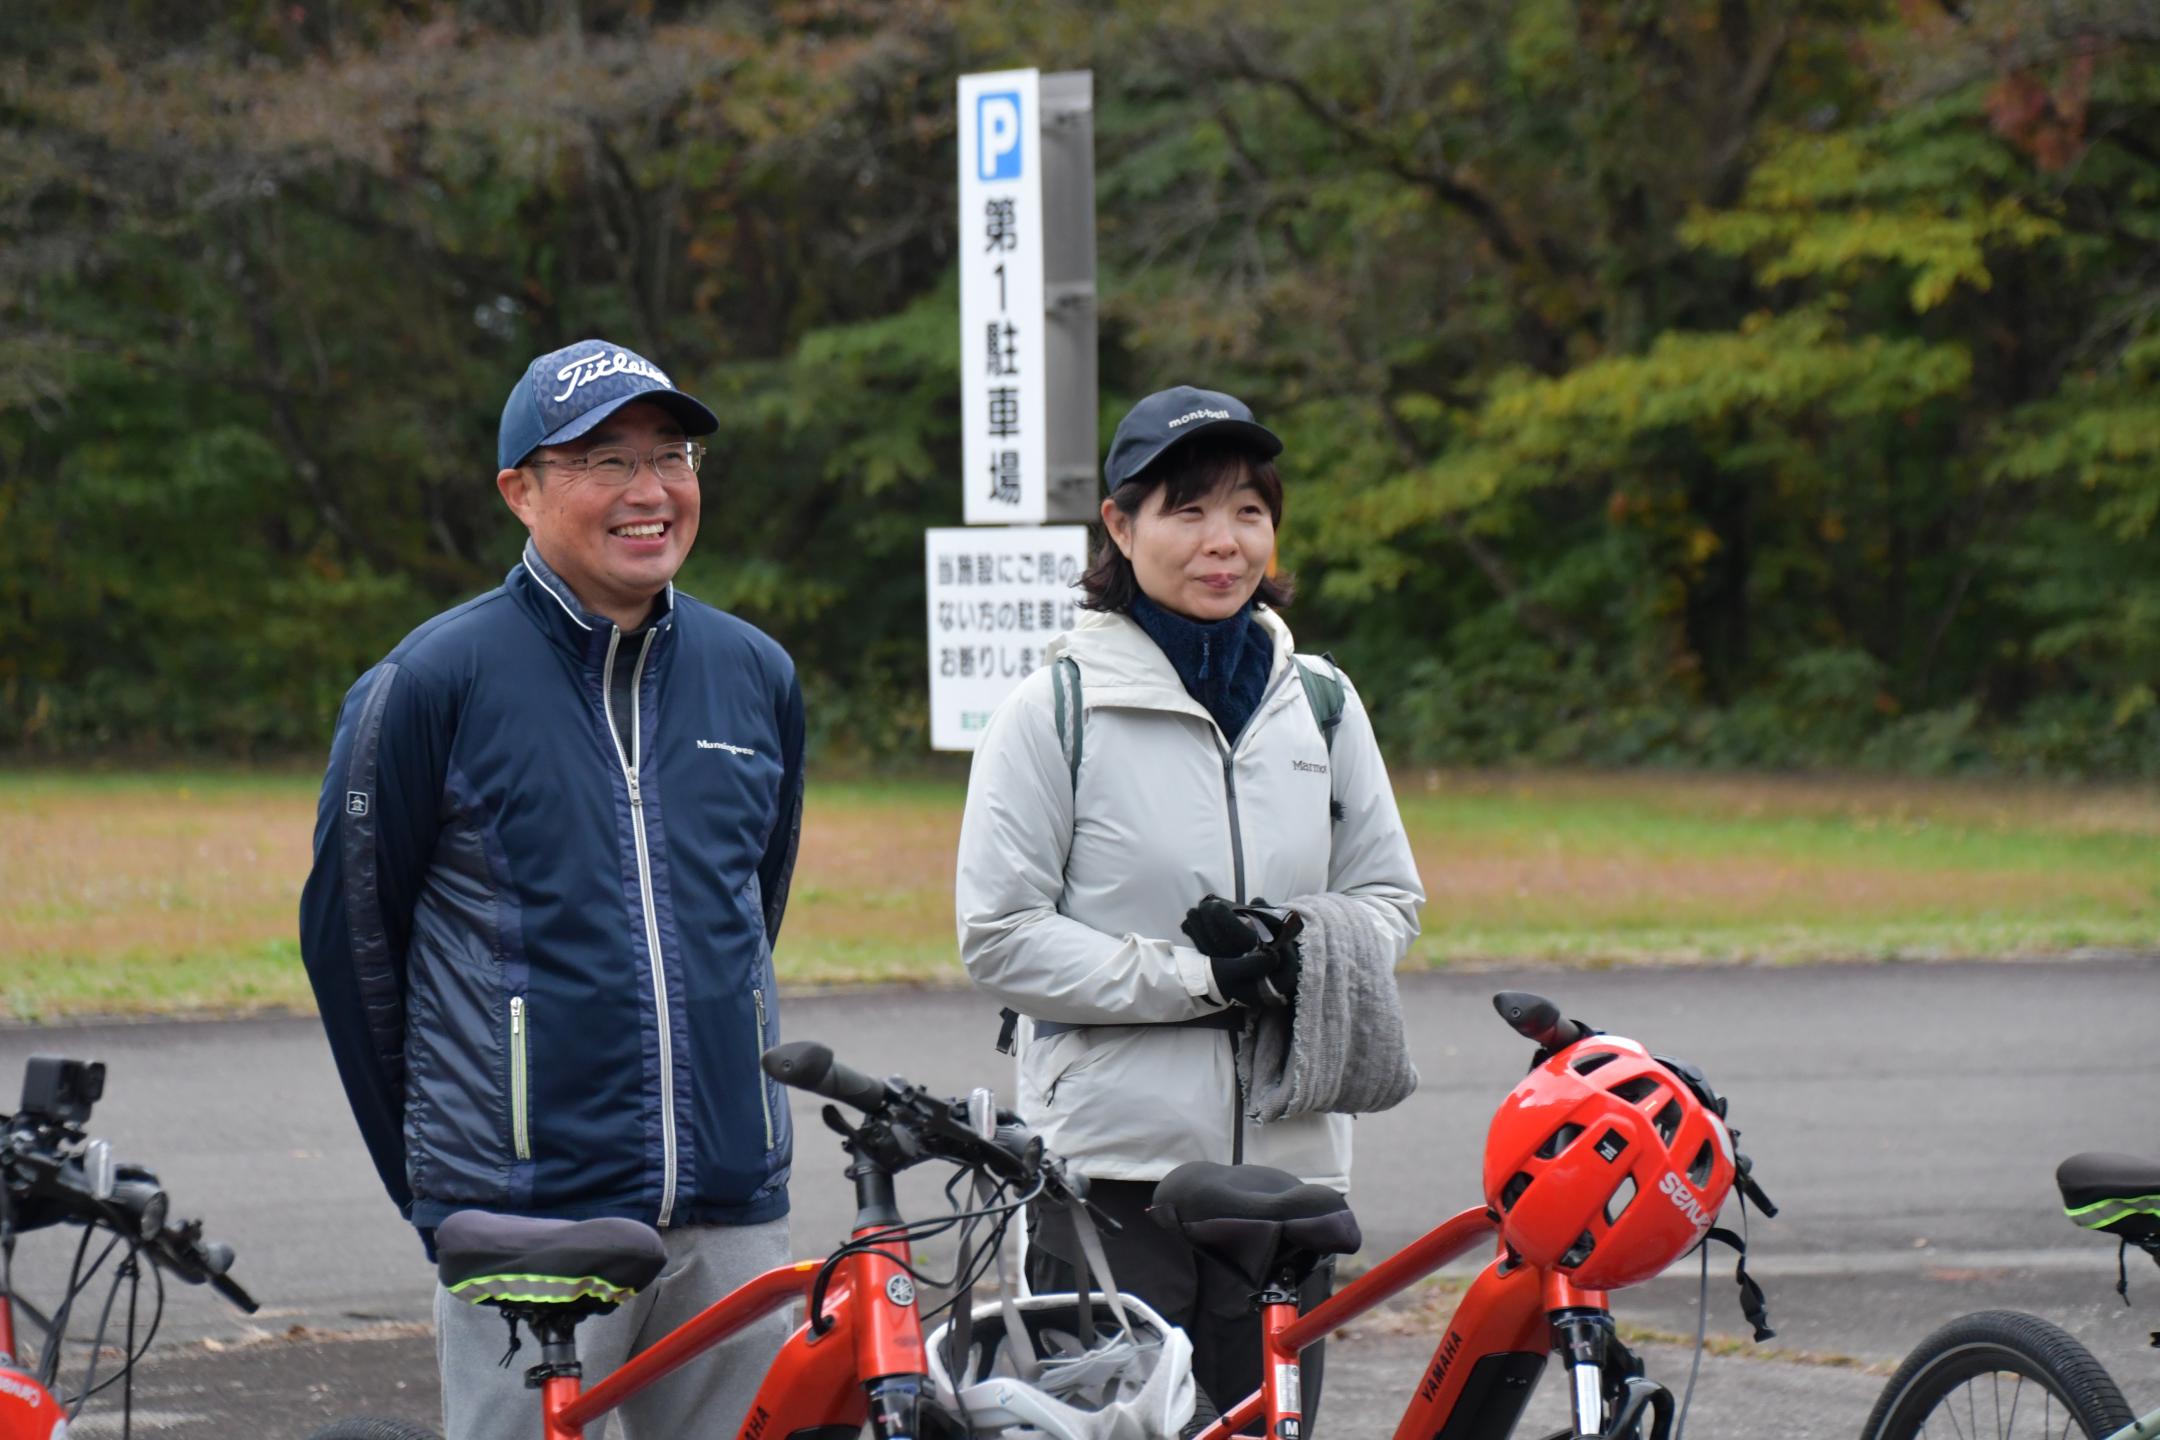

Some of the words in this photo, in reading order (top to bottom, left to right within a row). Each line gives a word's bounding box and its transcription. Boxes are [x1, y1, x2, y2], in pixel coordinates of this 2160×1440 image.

[981, 97, 1018, 177] P
[985, 198, 1020, 504] 第1駐車場
[940, 647, 1046, 678] お断りしま
[1422, 1331, 1463, 1403] YAMAHA
